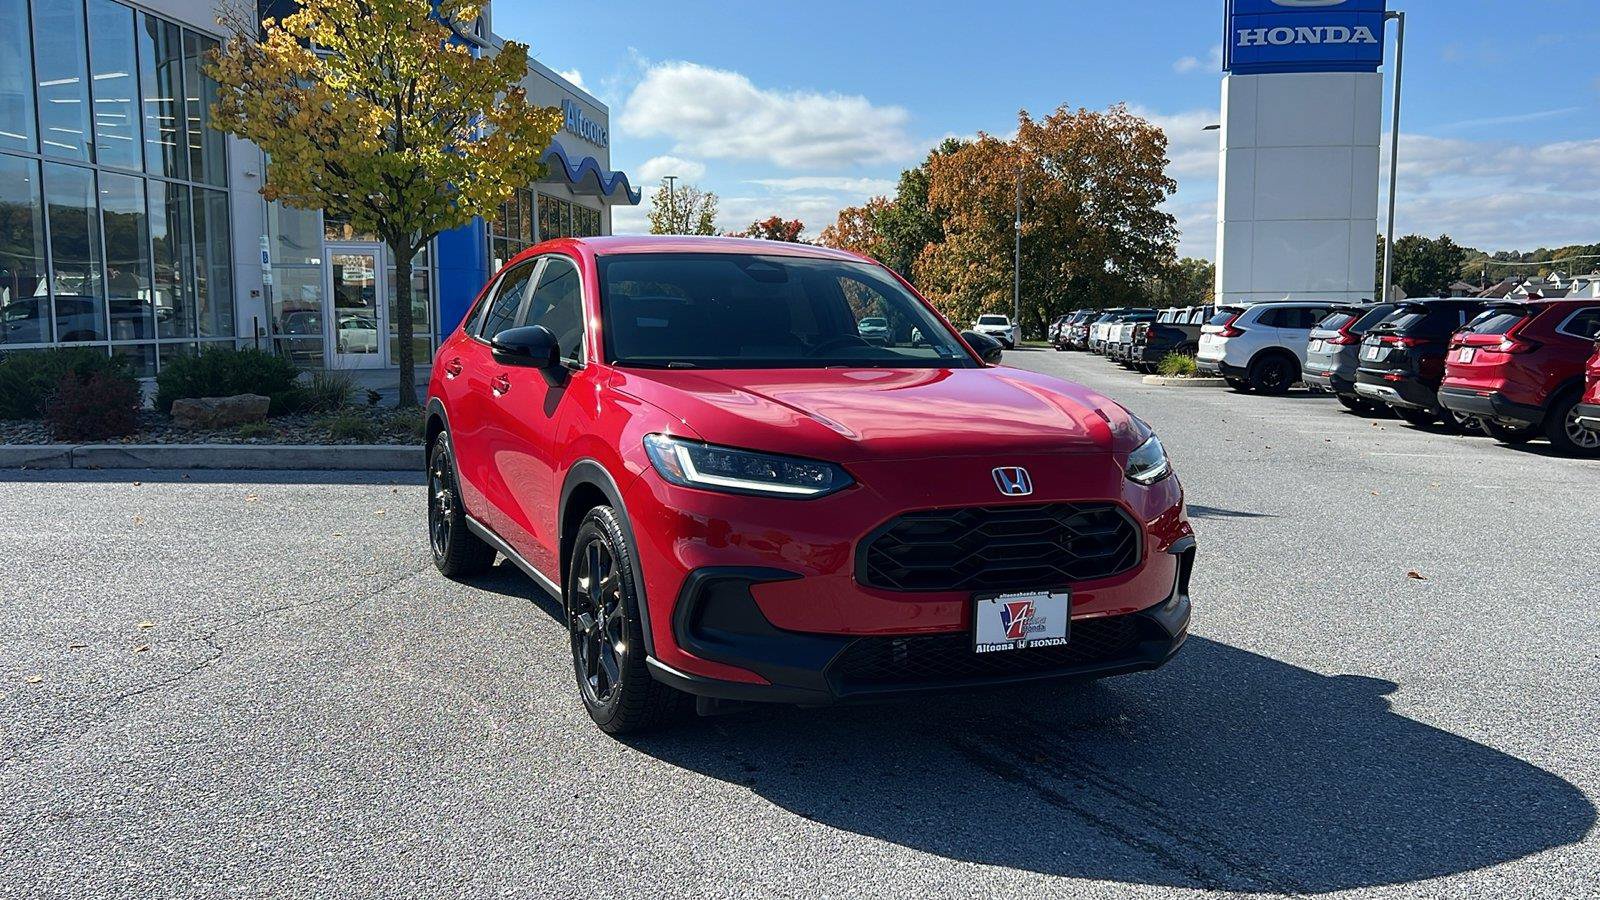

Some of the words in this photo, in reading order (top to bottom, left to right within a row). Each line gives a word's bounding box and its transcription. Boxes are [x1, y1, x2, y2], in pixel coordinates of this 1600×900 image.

[1237, 26, 1378, 46] HONDA
[565, 100, 608, 148] Altoona
[976, 643, 1014, 653] Altoona
[1030, 638, 1067, 648] HONDA
